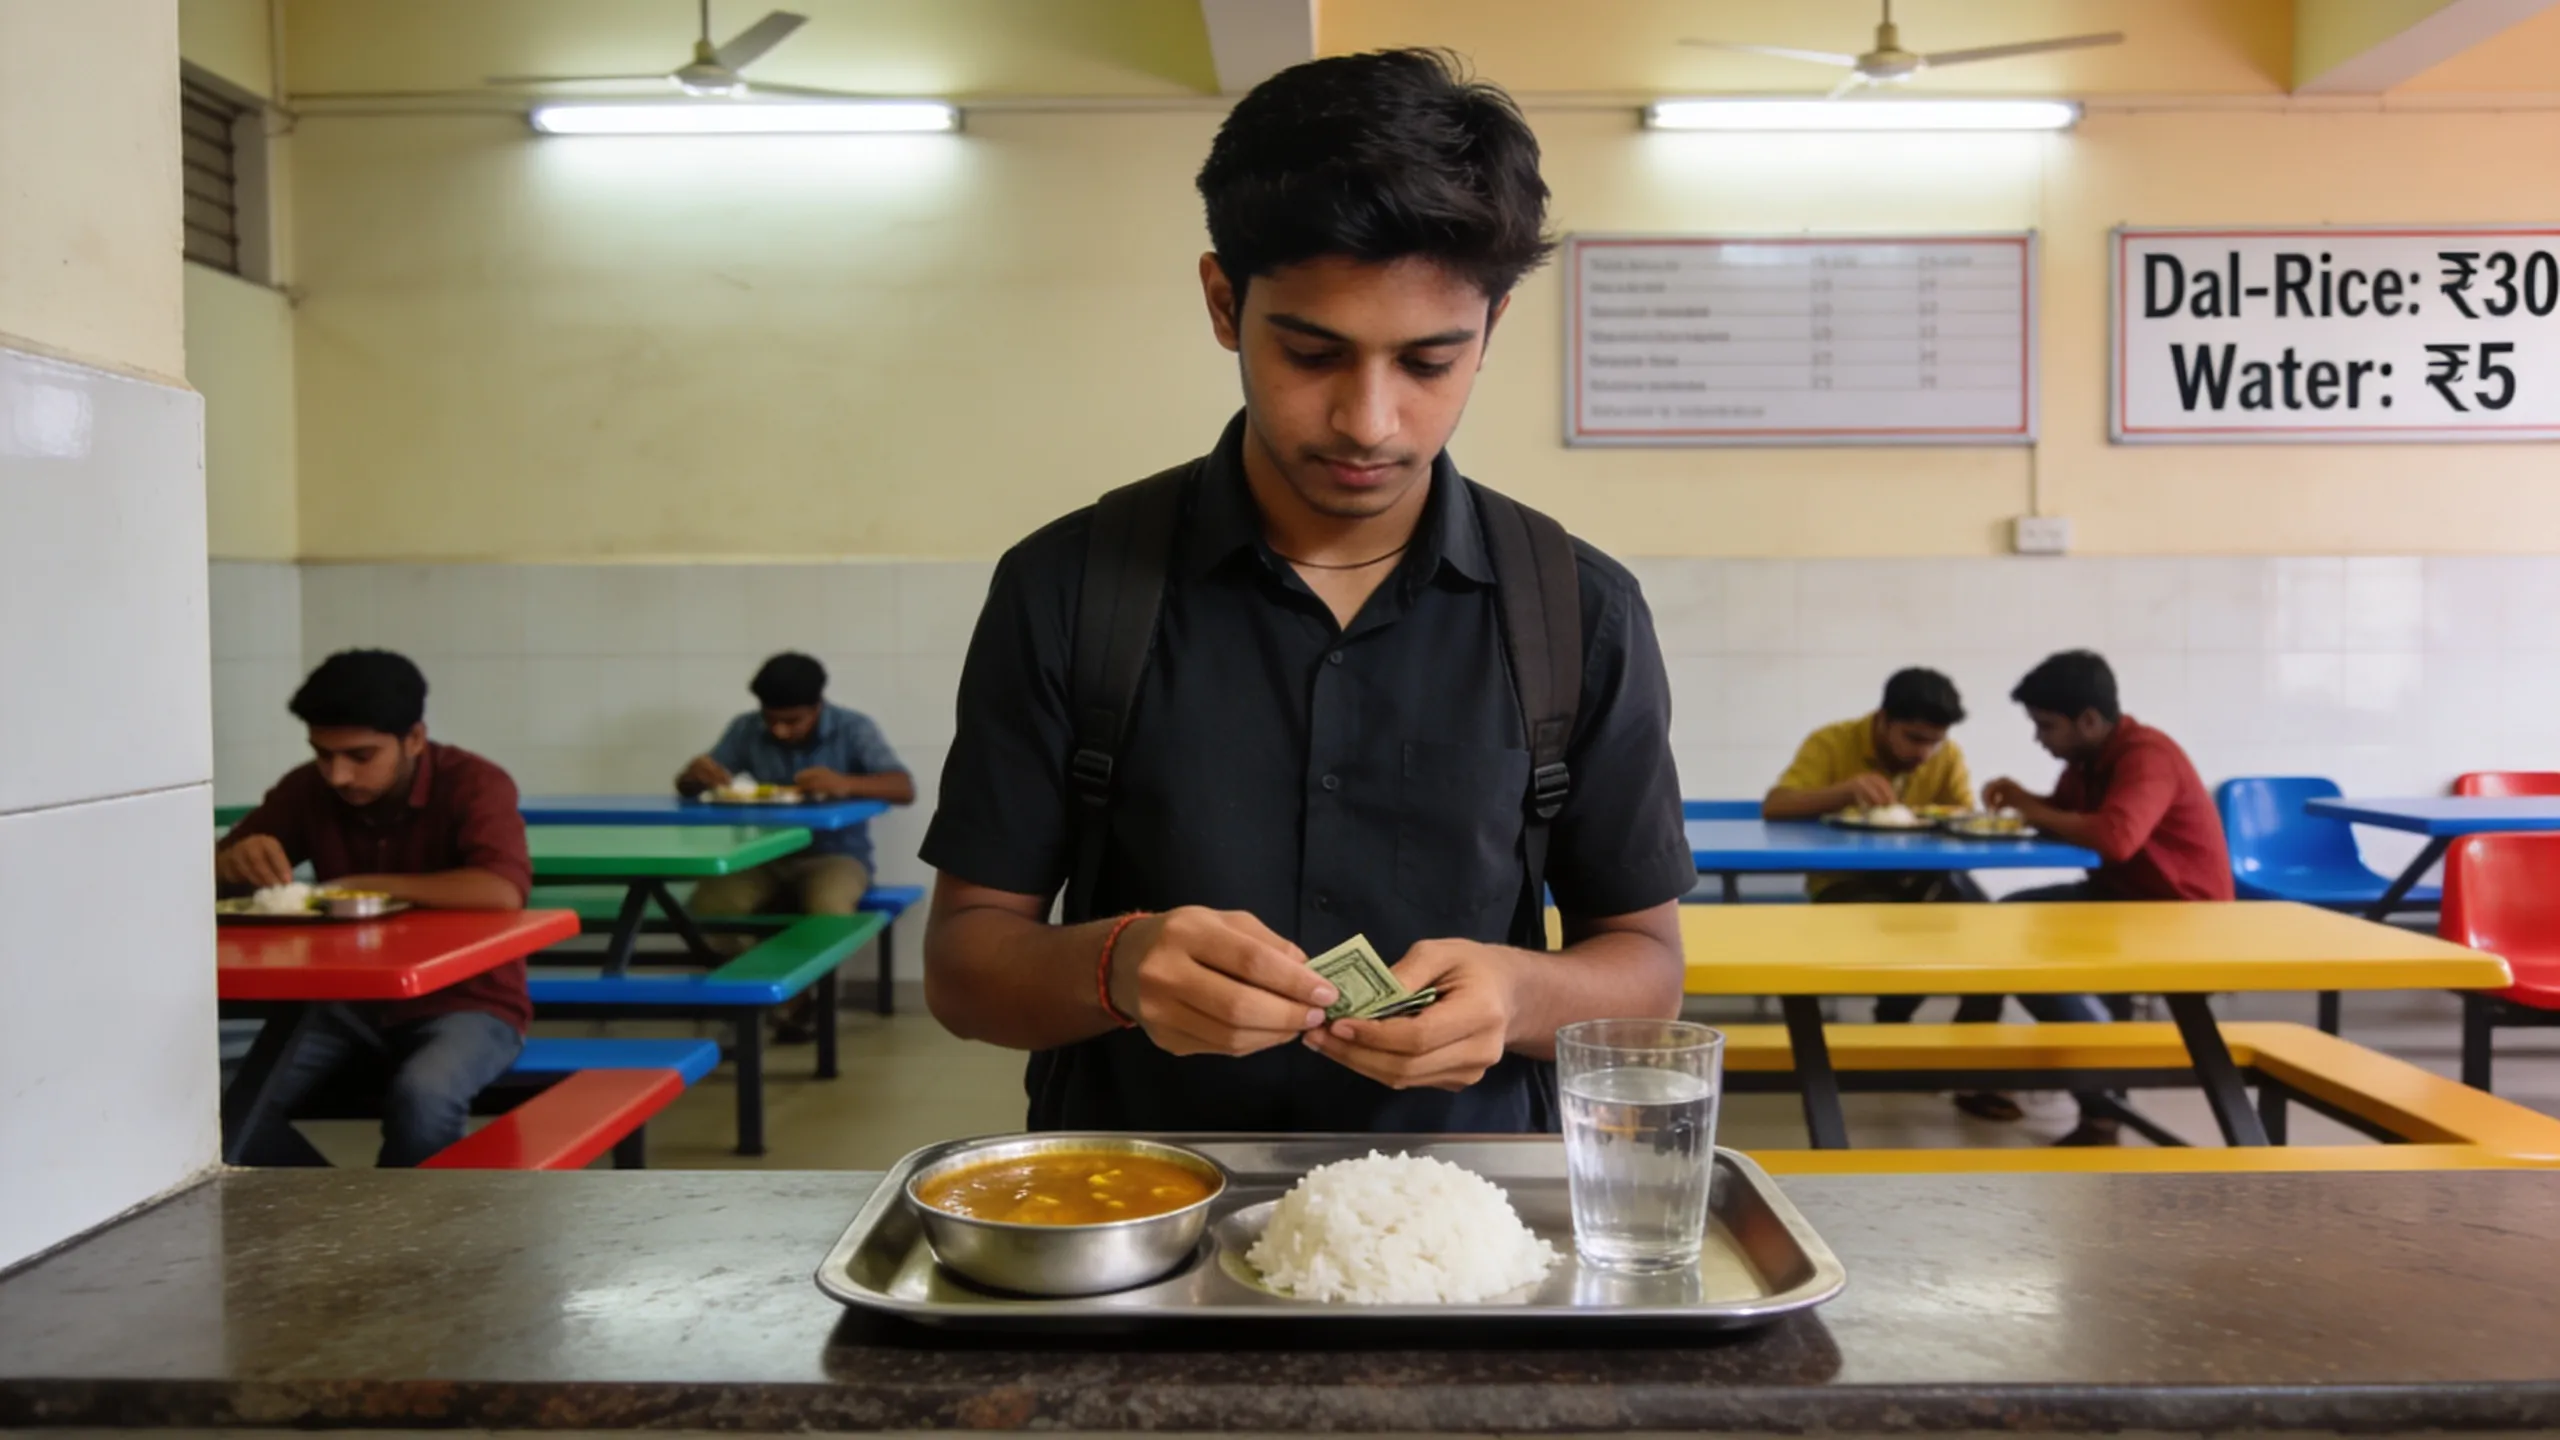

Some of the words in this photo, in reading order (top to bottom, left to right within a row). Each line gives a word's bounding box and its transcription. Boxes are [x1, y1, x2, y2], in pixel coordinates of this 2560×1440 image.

[2144, 250, 2420, 319] Dal-Rice:
[2437, 250, 2559, 319] ₹30
[2169, 343, 2393, 411] Water:
[2424, 342, 2516, 412] ₹5
